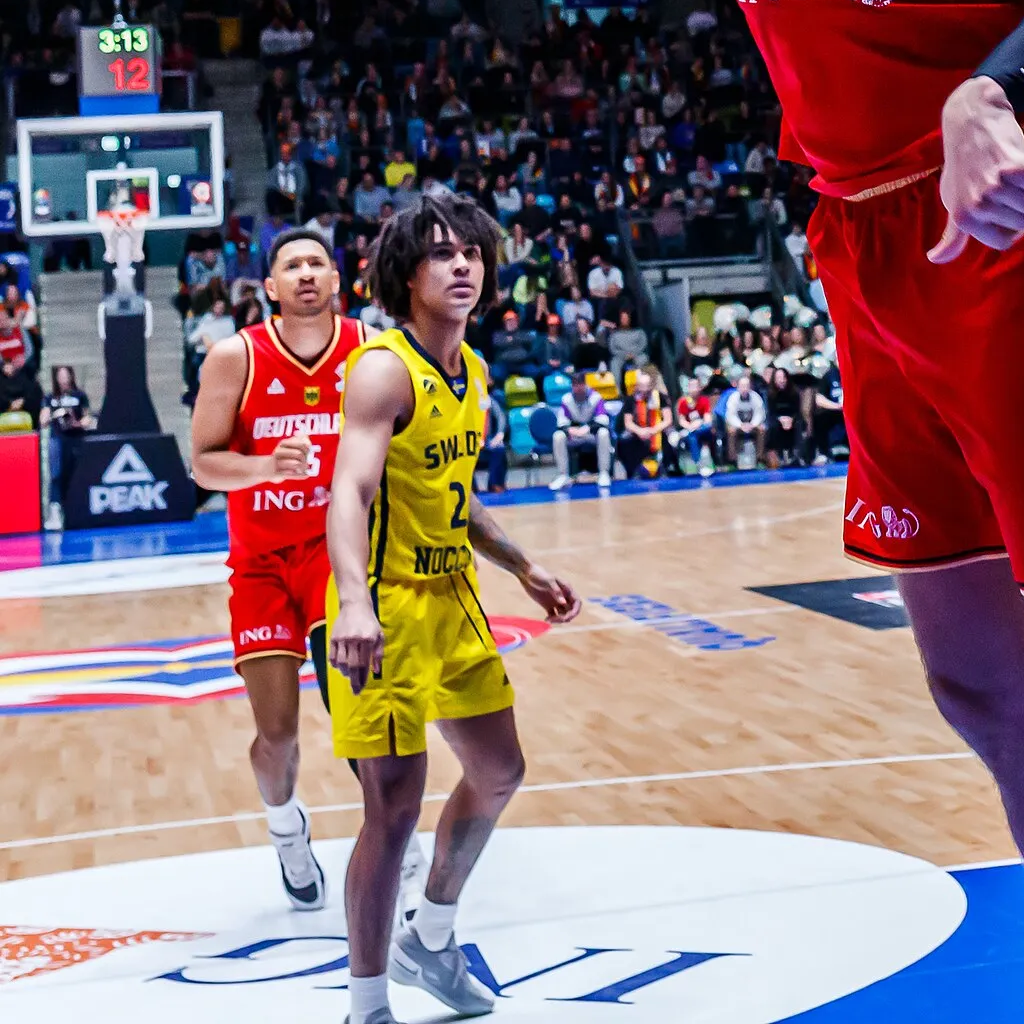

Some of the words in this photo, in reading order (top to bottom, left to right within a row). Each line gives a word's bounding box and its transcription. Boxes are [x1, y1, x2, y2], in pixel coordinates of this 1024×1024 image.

[98, 28, 149, 54] 3:13
[108, 57, 151, 91] 12
[89, 480, 169, 515] PEAK
[253, 489, 305, 512] ING
[448, 481, 468, 529] 2
